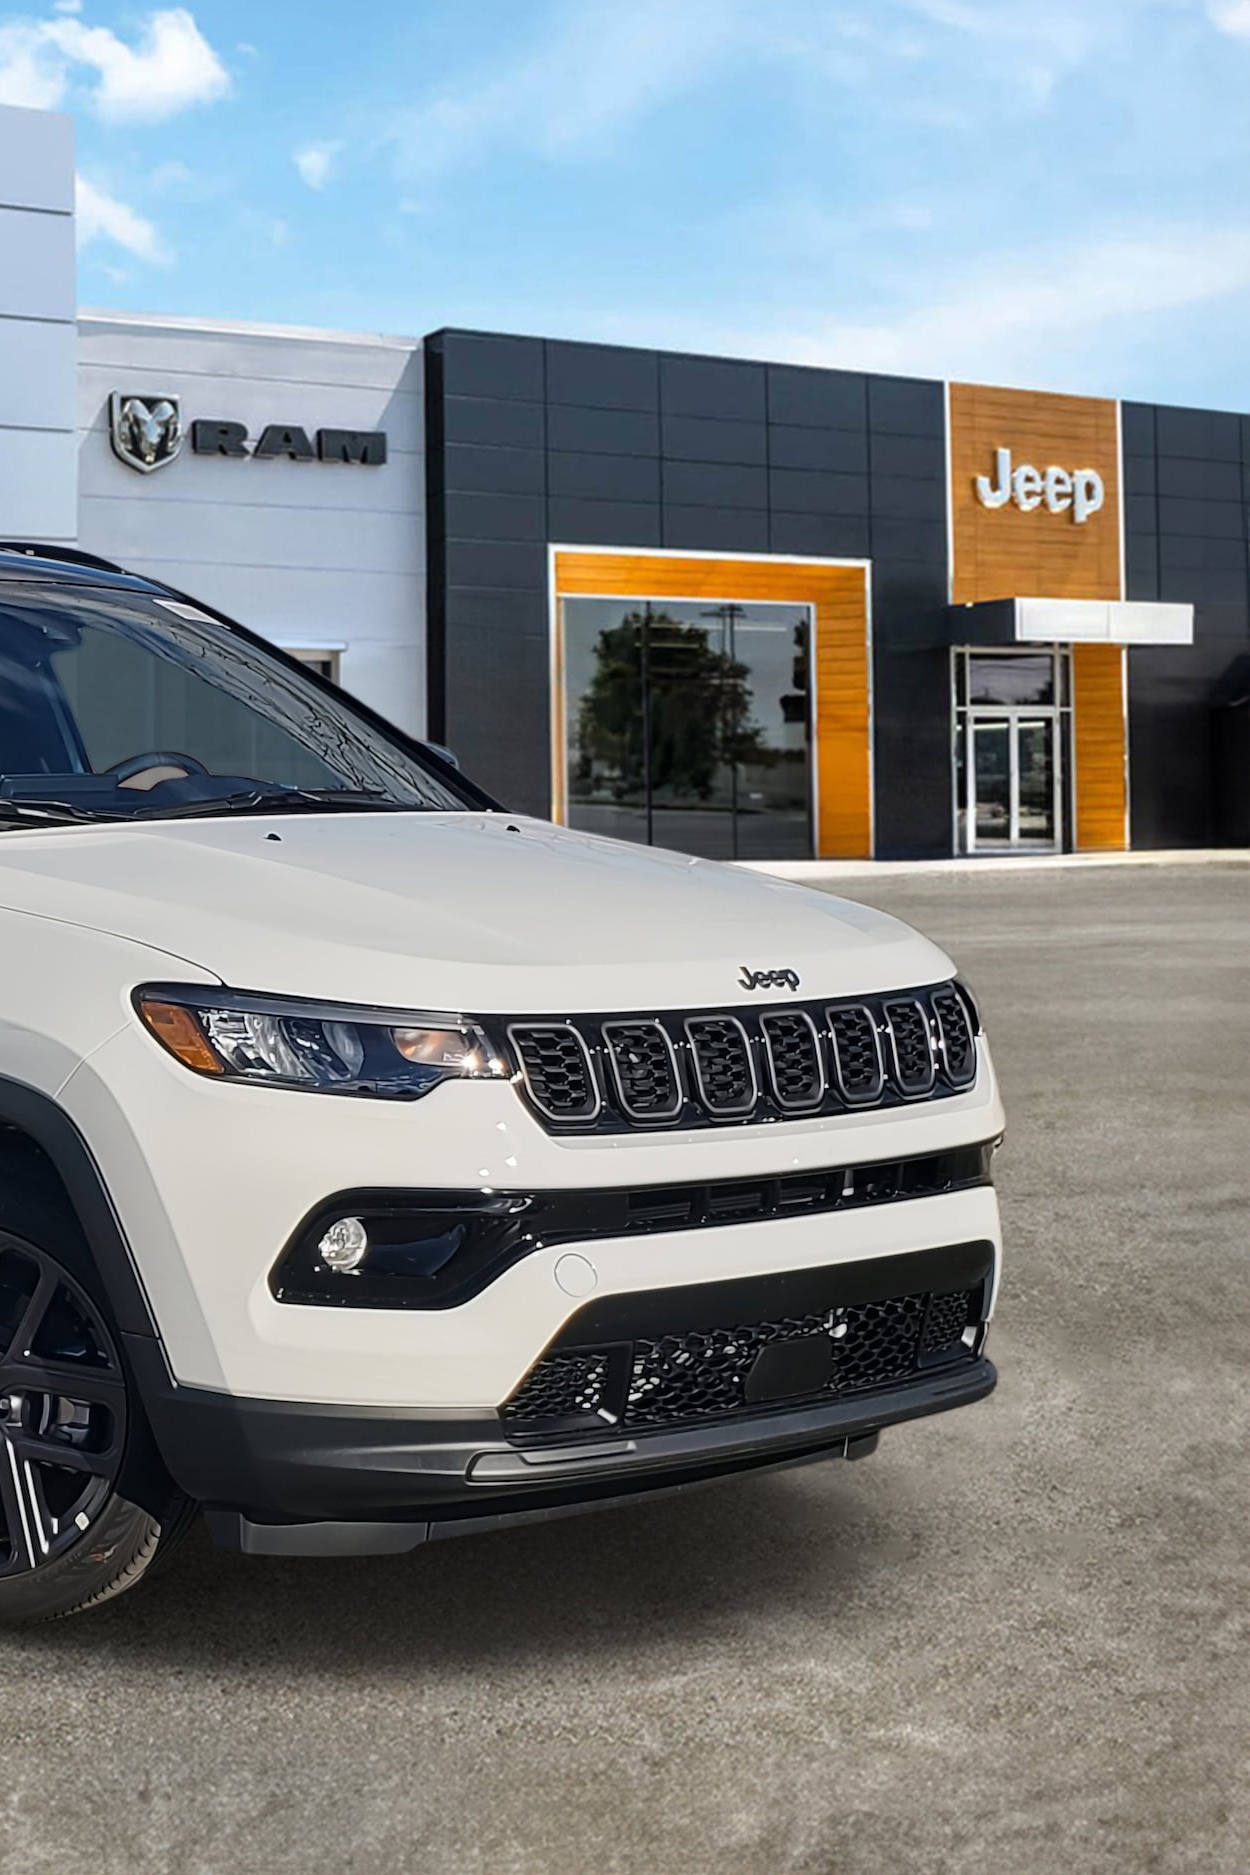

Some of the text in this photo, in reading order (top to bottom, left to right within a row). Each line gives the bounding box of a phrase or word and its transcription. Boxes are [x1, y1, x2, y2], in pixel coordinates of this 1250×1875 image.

[192, 419, 387, 465] RAM
[976, 448, 1104, 523] Jeep
[737, 966, 800, 992] Jeep
